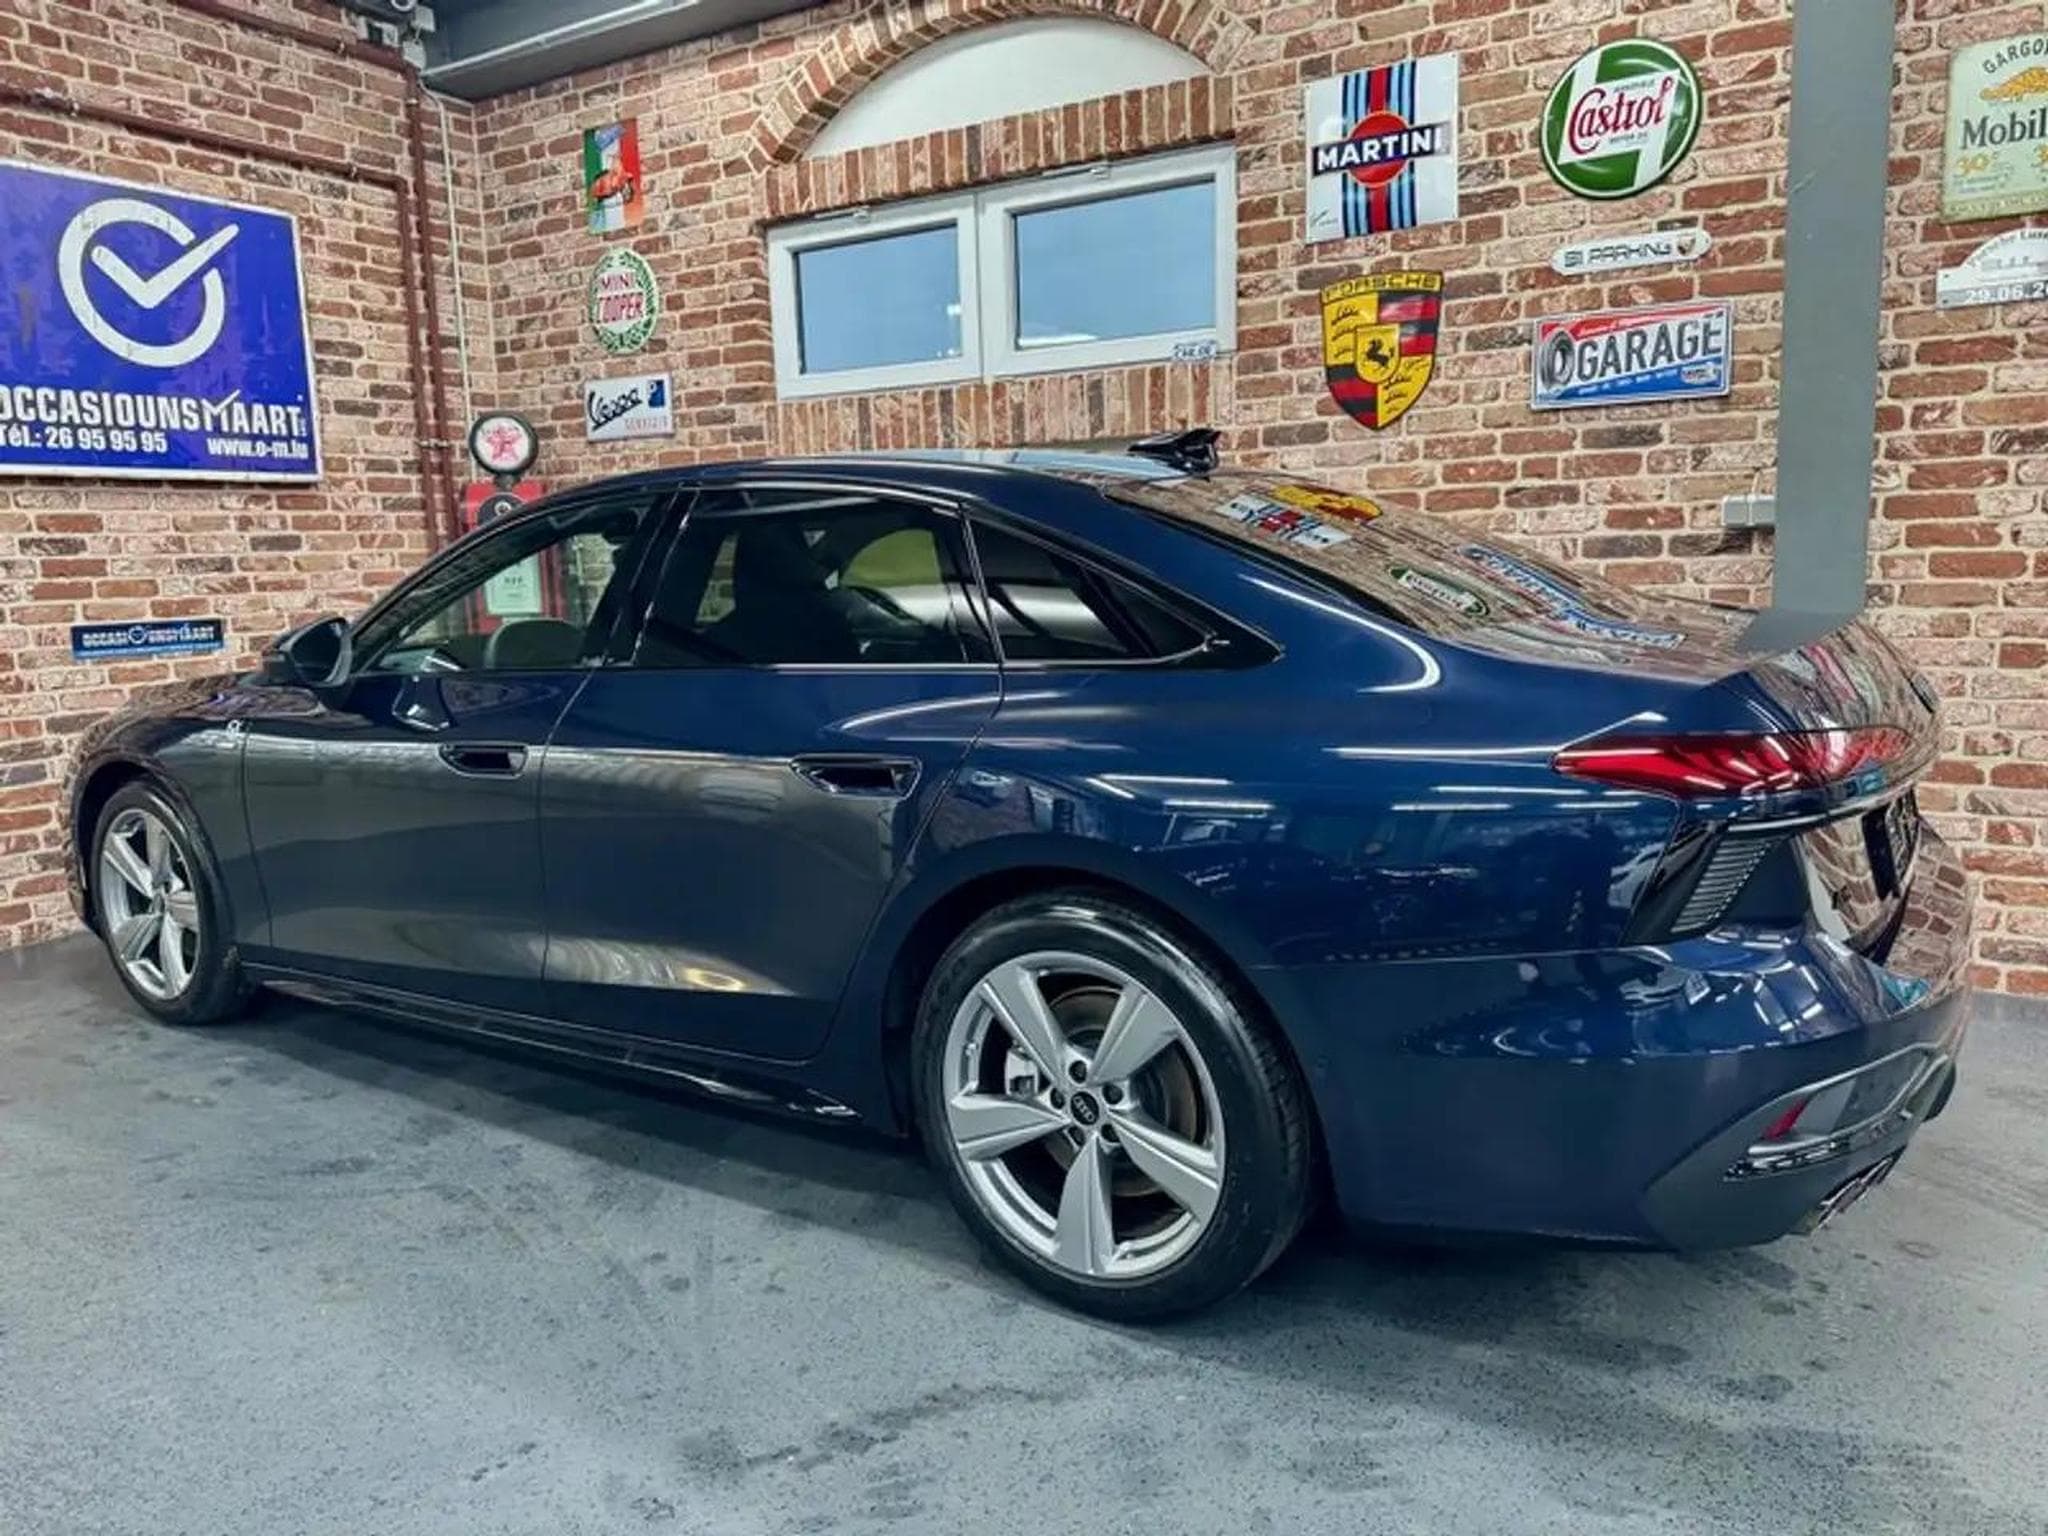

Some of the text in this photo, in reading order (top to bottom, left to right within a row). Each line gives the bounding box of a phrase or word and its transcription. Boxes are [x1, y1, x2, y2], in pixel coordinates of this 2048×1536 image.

[1569, 76, 1673, 155] Castrol
[1317, 128, 1441, 171] MARTINI
[1589, 243, 1672, 263] PARKING
[598, 271, 634, 290] MINI
[1322, 274, 1440, 302] PORSCHE
[596, 292, 644, 323] COOPER
[1577, 311, 1724, 382] GARAGE
[0, 384, 301, 437] OCCASIOUNSMAART
[588, 388, 642, 432] Vespa
[44, 425, 74, 449] 26
[77, 427, 106, 450] 95
[110, 429, 137, 451] 95
[141, 431, 167, 453] 95
